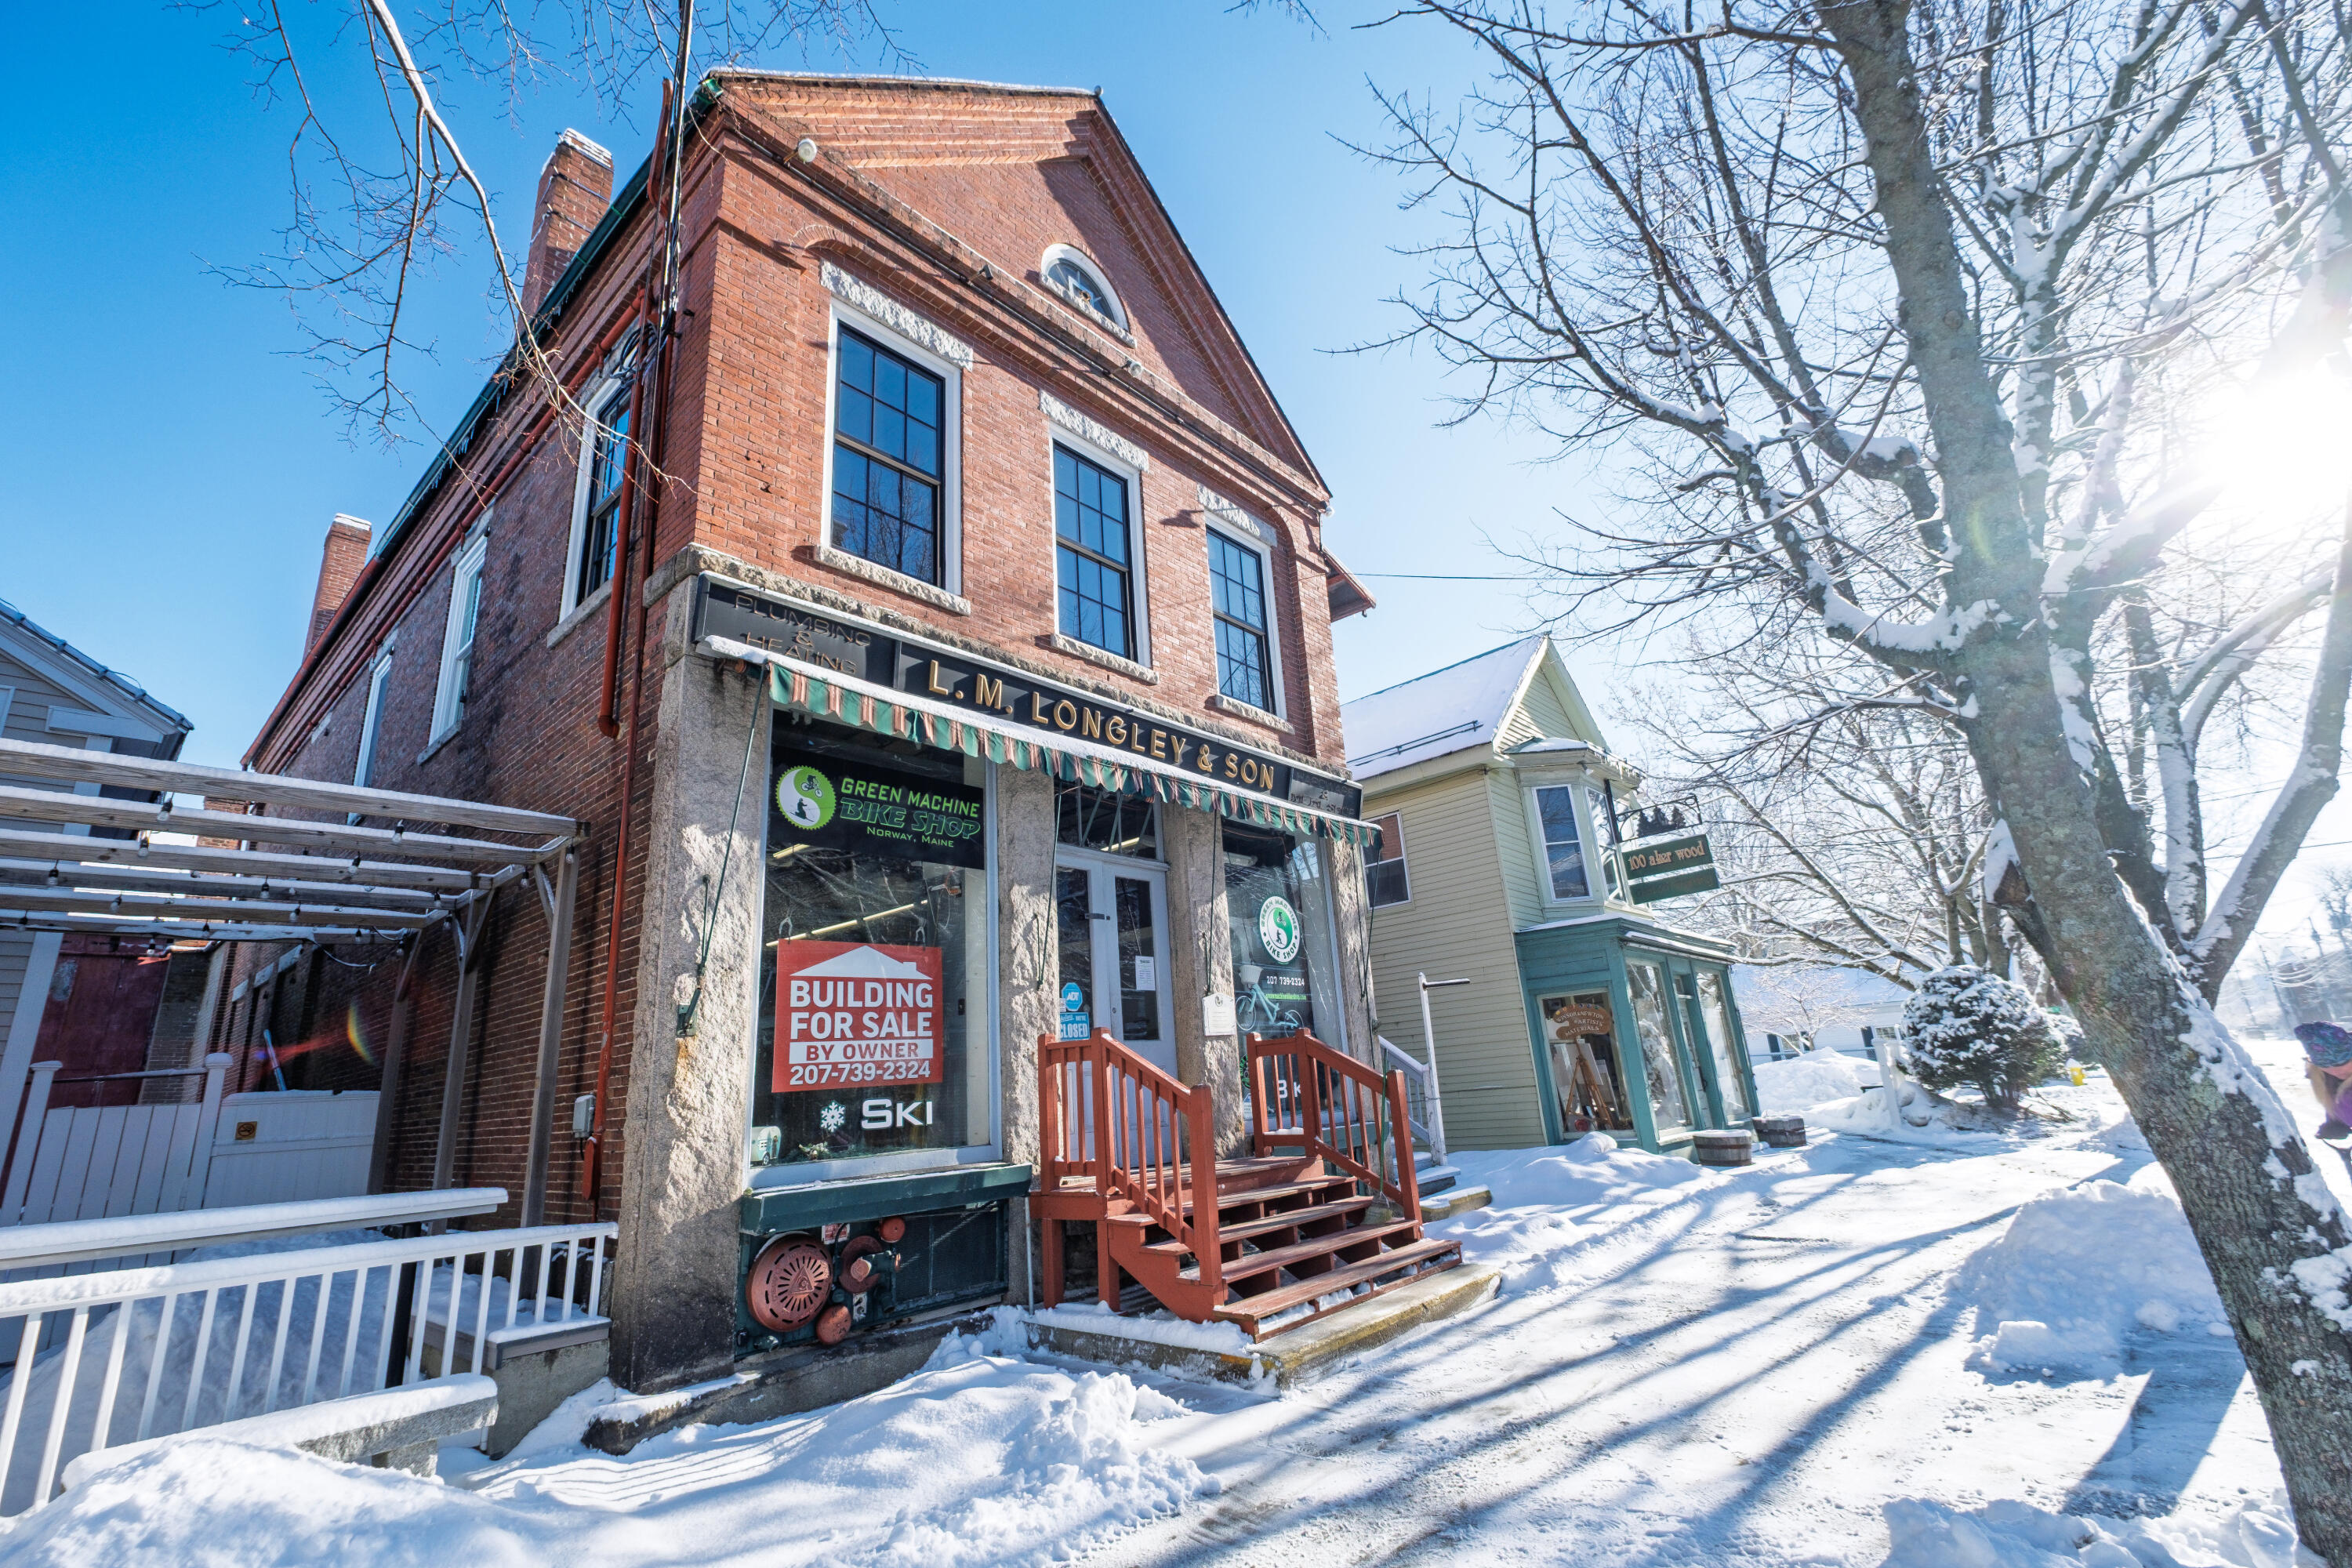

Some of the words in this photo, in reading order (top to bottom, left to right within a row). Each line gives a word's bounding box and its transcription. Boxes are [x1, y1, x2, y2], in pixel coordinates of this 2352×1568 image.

[734, 594, 872, 647] PLUMBING
[795, 630, 815, 648] &
[746, 631, 858, 675] HEATING
[928, 659, 964, 699] L.
[975, 673, 1014, 714] M.
[1032, 691, 1186, 764] LONGLEY
[1196, 744, 1213, 772] &
[1224, 753, 1274, 790] SON
[840, 777, 902, 804] GREEN
[908, 789, 980, 818] MACHINE
[840, 797, 907, 828] BIKE
[911, 810, 981, 840] SHOP
[866, 826, 916, 843] NORWAY,
[921, 835, 954, 848] MAINE
[1628, 854, 1646, 870] 100
[1649, 850, 1672, 866] aker
[1675, 840, 1705, 860] wood
[1265, 940, 1280, 958] BIKE
[1283, 942, 1298, 960] SHOP
[1266, 975, 1278, 985] 207
[1279, 976, 1305, 986] 739-2324
[789, 980, 933, 1008] BUILDING
[1066, 991, 1080, 1001] ADT
[789, 1011, 853, 1040] FOR
[862, 1011, 932, 1038] SALE
[1060, 1022, 1088, 1038] CLOSED
[1566, 1026, 1600, 1036] MATERIALS
[806, 1044, 834, 1062] BY
[843, 1042, 919, 1059] OWNER
[789, 1061, 931, 1085] 207-739-2324
